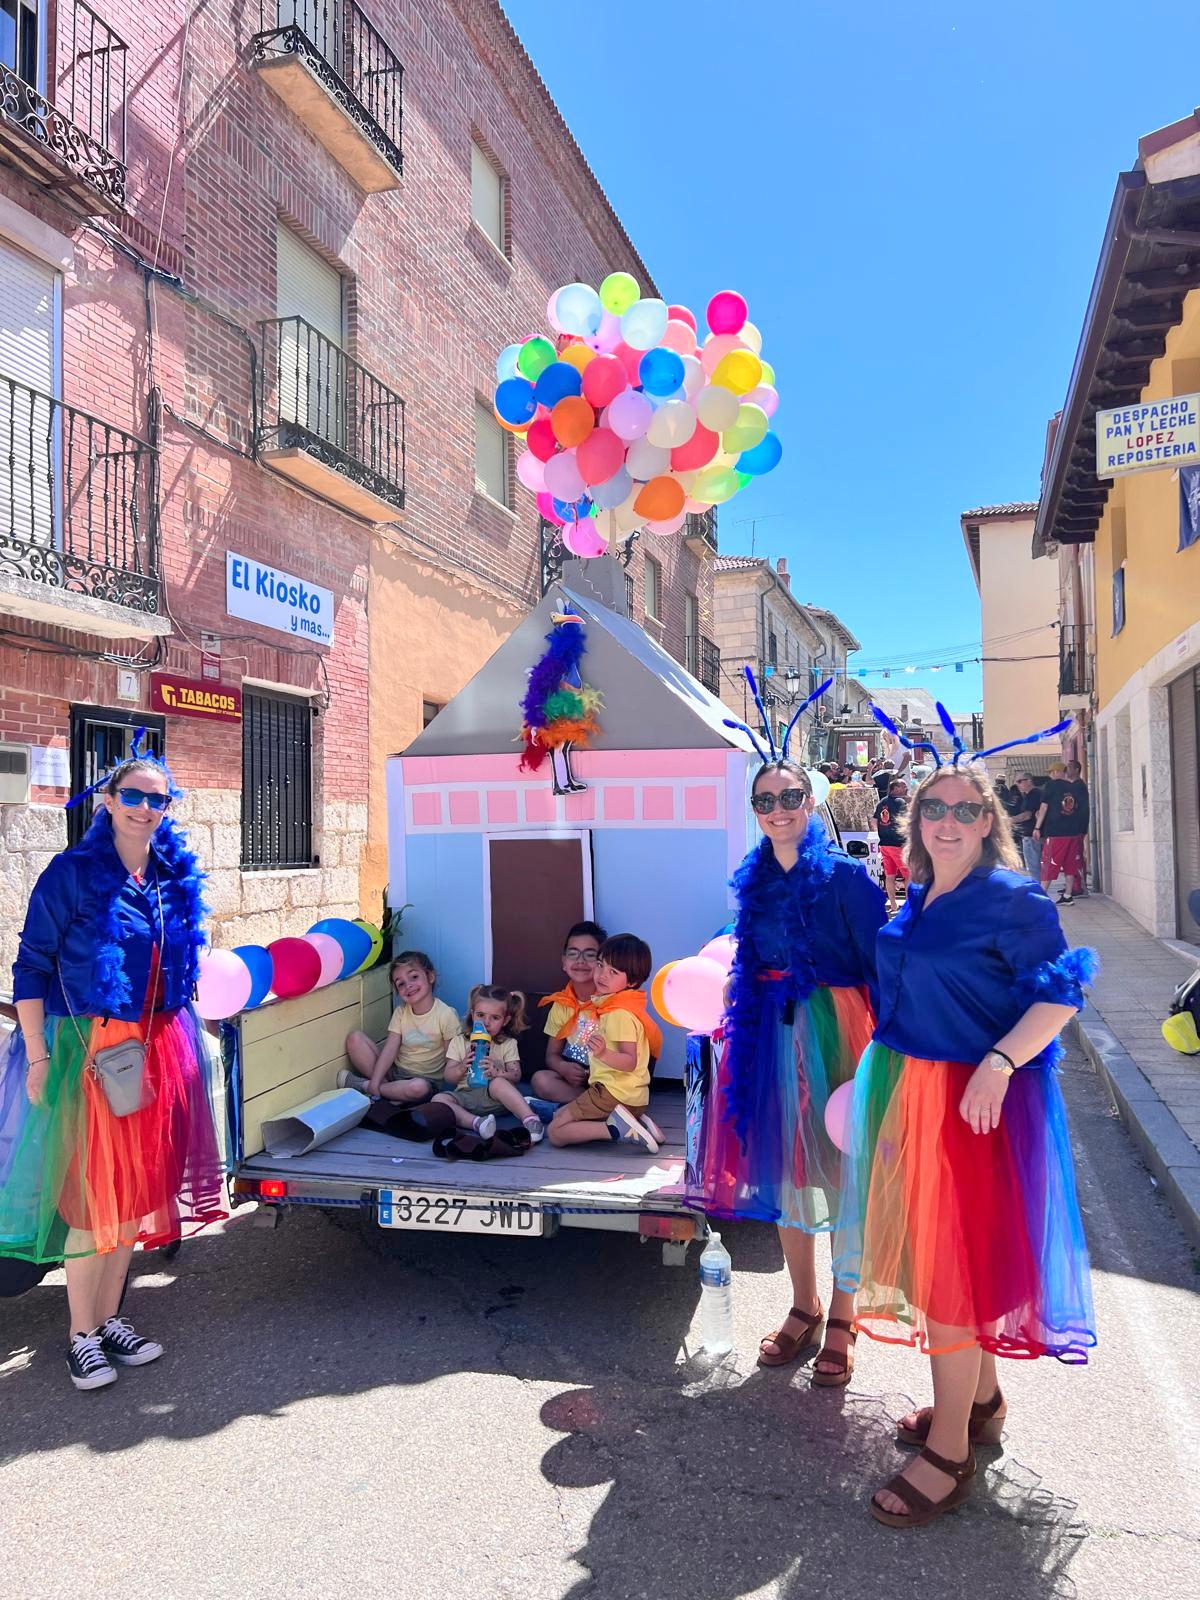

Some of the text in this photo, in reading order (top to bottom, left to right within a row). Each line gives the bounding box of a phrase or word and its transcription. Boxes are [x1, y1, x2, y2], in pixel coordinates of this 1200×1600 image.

[1106, 408, 1196, 439] PAN Y LECHE
[1113, 401, 1188, 425] DESPACHO
[1127, 431, 1175, 449] LOPEZ
[1108, 442, 1196, 467] REPOSTERIA
[232, 558, 321, 615] El Kiosko
[290, 614, 330, 639] y mas...
[126, 676, 133, 692] 7
[180, 687, 235, 711] TABACOS
[382, 1210, 389, 1219] E
[398, 1195, 534, 1230] 3227 JWD
